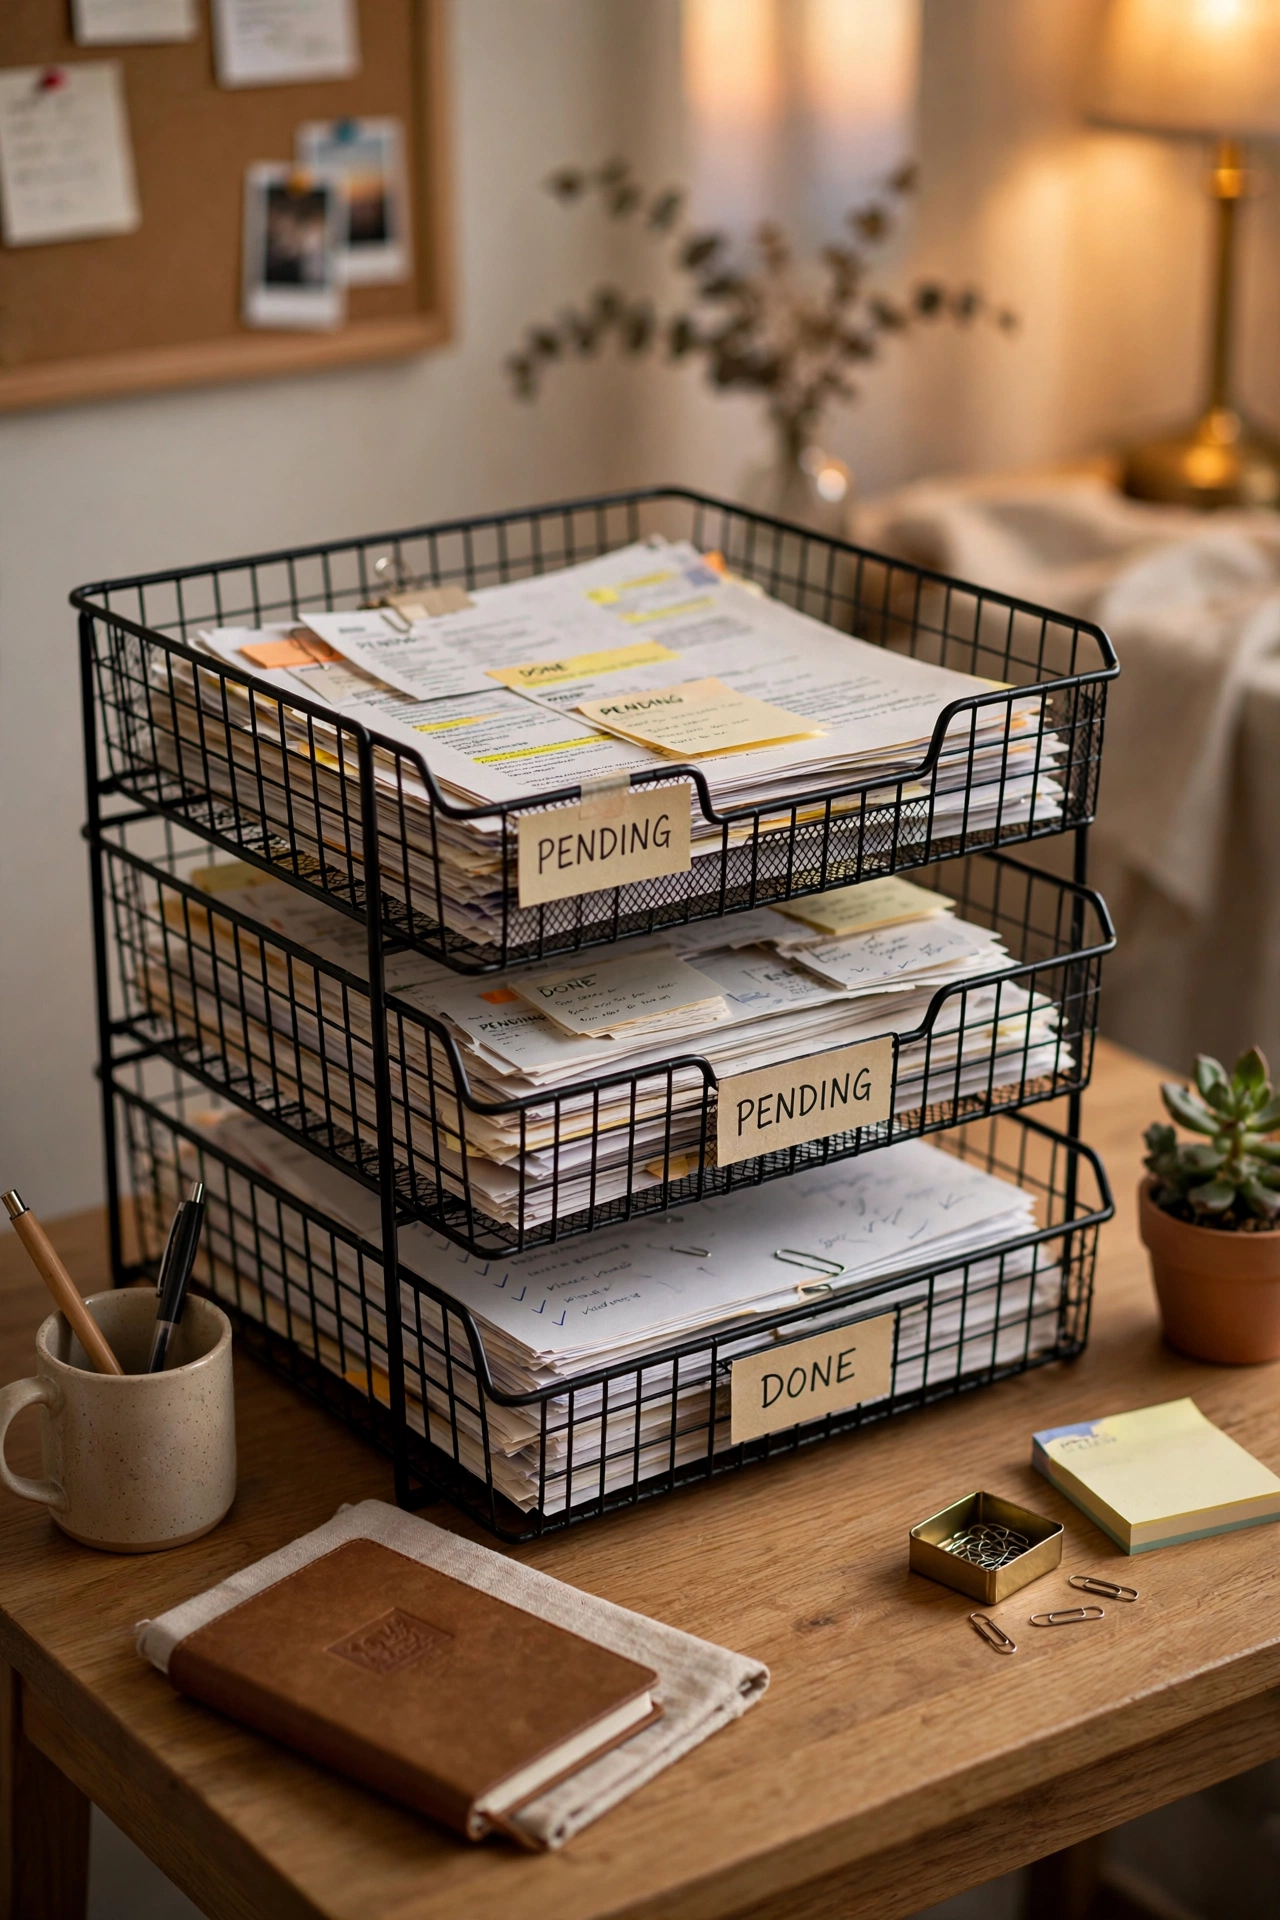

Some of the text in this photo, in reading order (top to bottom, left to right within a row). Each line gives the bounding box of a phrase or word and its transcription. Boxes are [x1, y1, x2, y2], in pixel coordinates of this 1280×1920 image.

[600, 694, 683, 716] PENDING
[537, 814, 672, 875] PENDING
[538, 974, 597, 998] DONE
[736, 1067, 872, 1137] PENDING
[761, 1347, 856, 1409] DONE
